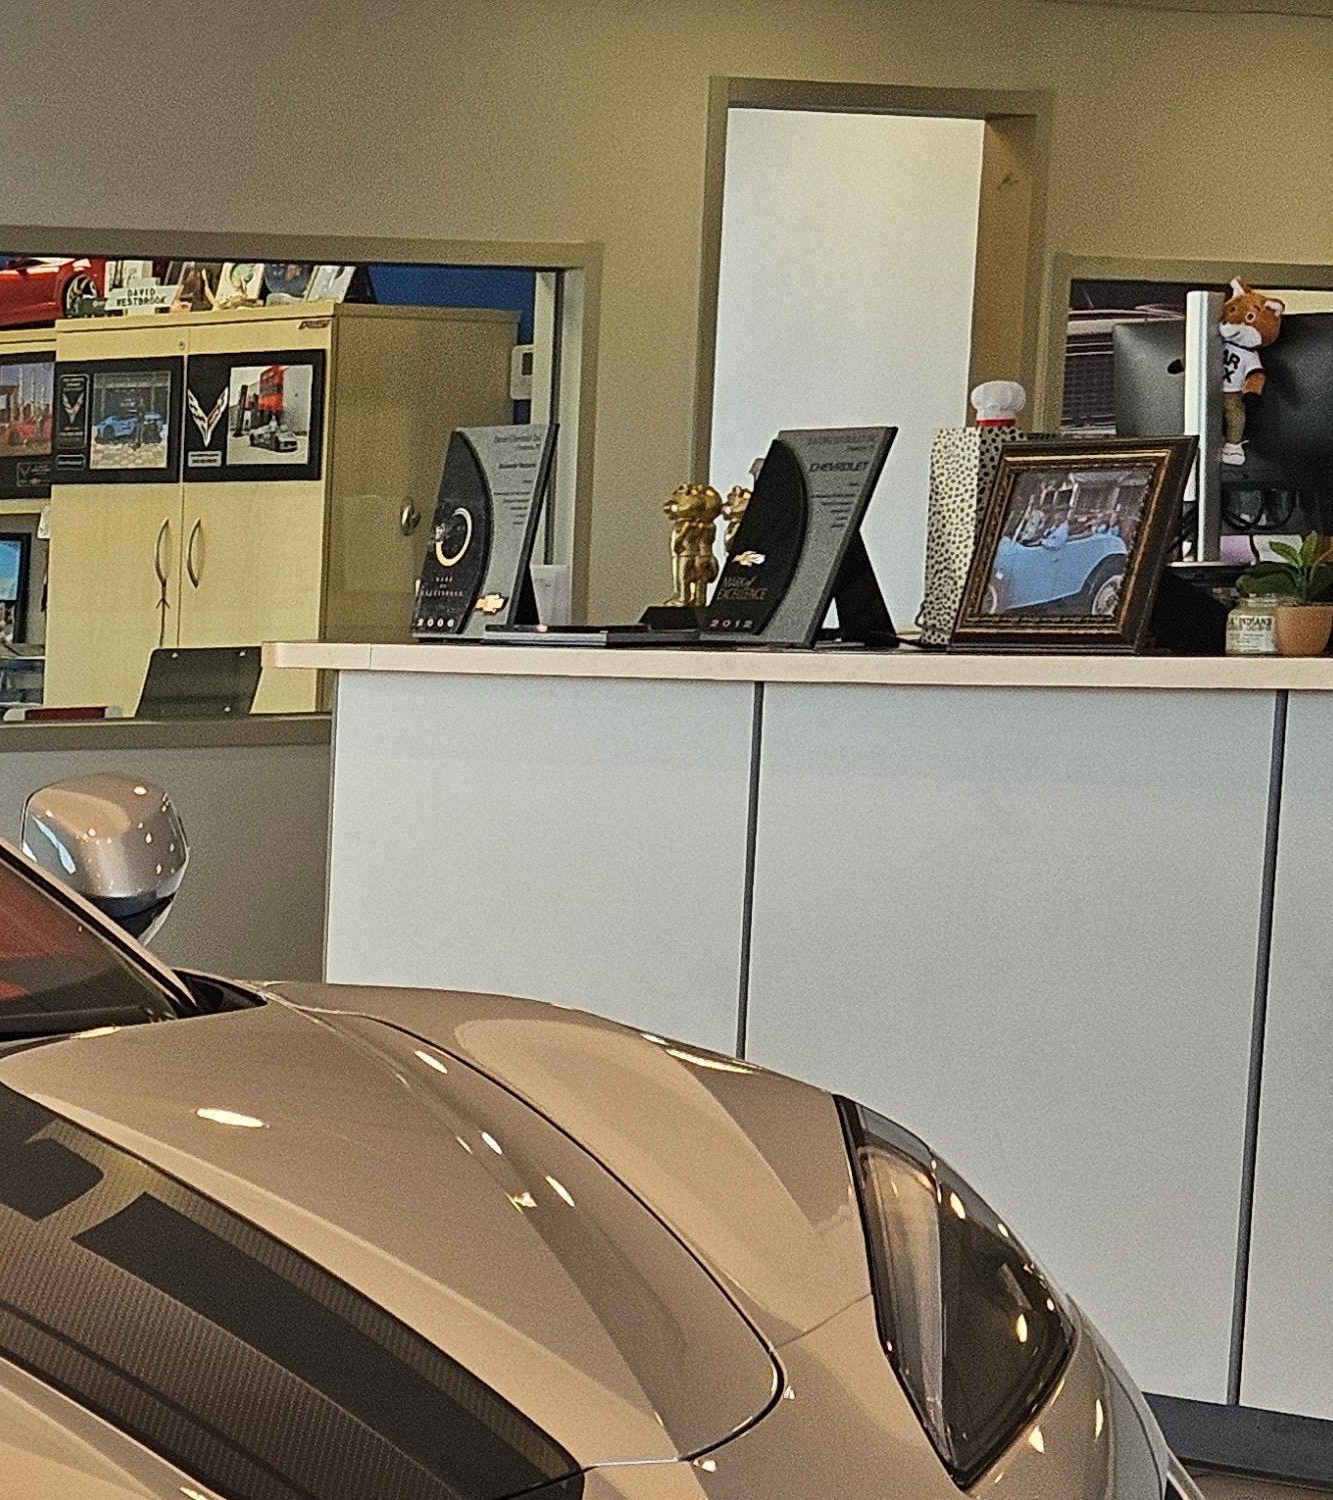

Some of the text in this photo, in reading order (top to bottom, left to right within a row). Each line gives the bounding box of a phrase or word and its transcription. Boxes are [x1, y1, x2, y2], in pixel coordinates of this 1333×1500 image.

[126, 287, 157, 297] DAVID
[116, 296, 167, 307] WESTBROOK
[1222, 349, 1241, 370] AR
[709, 619, 754, 629] 2012
